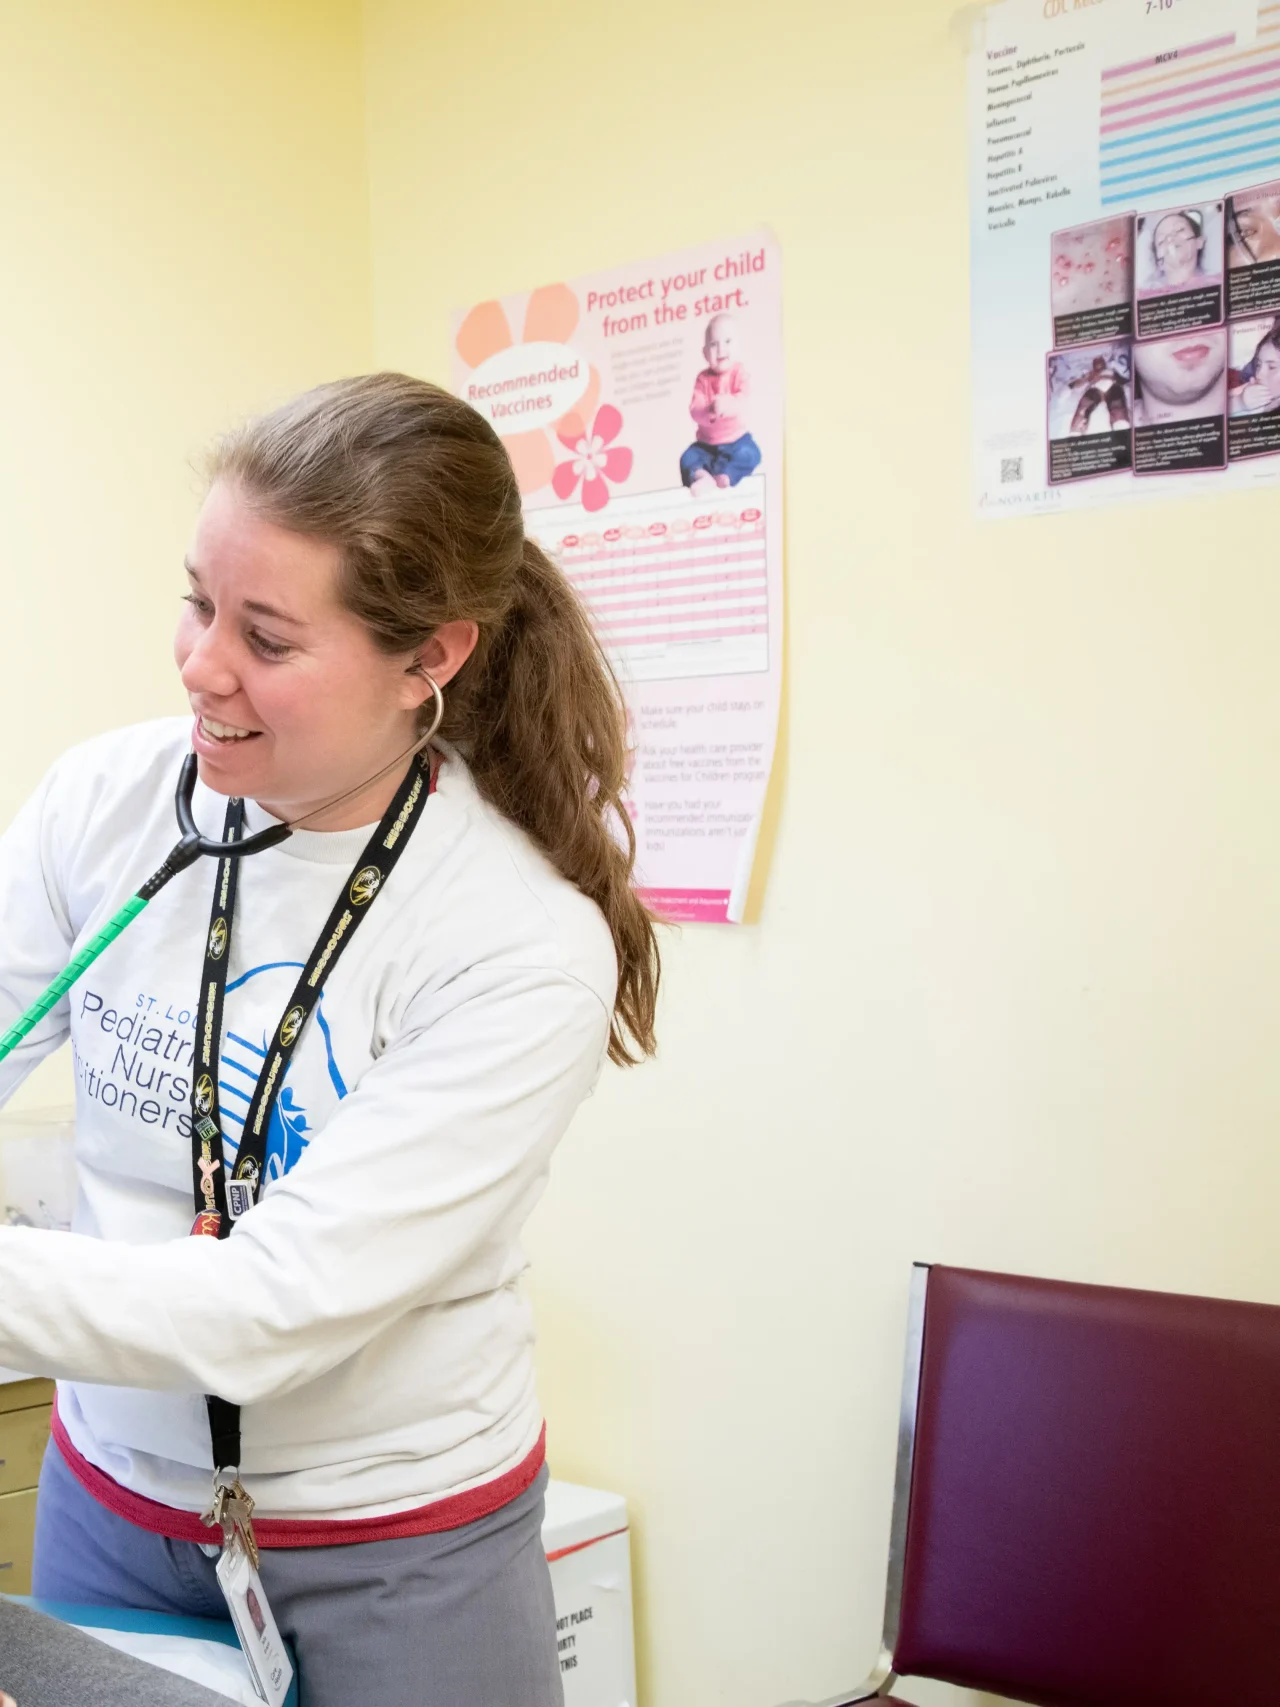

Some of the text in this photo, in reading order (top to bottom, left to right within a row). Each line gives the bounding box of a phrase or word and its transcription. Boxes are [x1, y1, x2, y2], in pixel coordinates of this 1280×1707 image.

[986, 45, 1018, 60] Vaccine
[1155, 50, 1178, 64] MCV4
[587, 248, 766, 312] Protect your child
[603, 288, 749, 338] from the start.
[468, 360, 580, 401] Recommended
[491, 394, 553, 419] Vaccines
[308, 910, 353, 987] MISSOURI
[136, 993, 160, 1015] ST.
[111, 1043, 192, 1103] Nurs
[253, 1052, 283, 1136] MISSOURI
[201, 1126, 216, 1139] LIFE
[231, 1187, 241, 1214] CPNP
[570, 1606, 593, 1626] PLACE
[558, 1634, 576, 1652] IRTY
[560, 1655, 578, 1672] THIS
